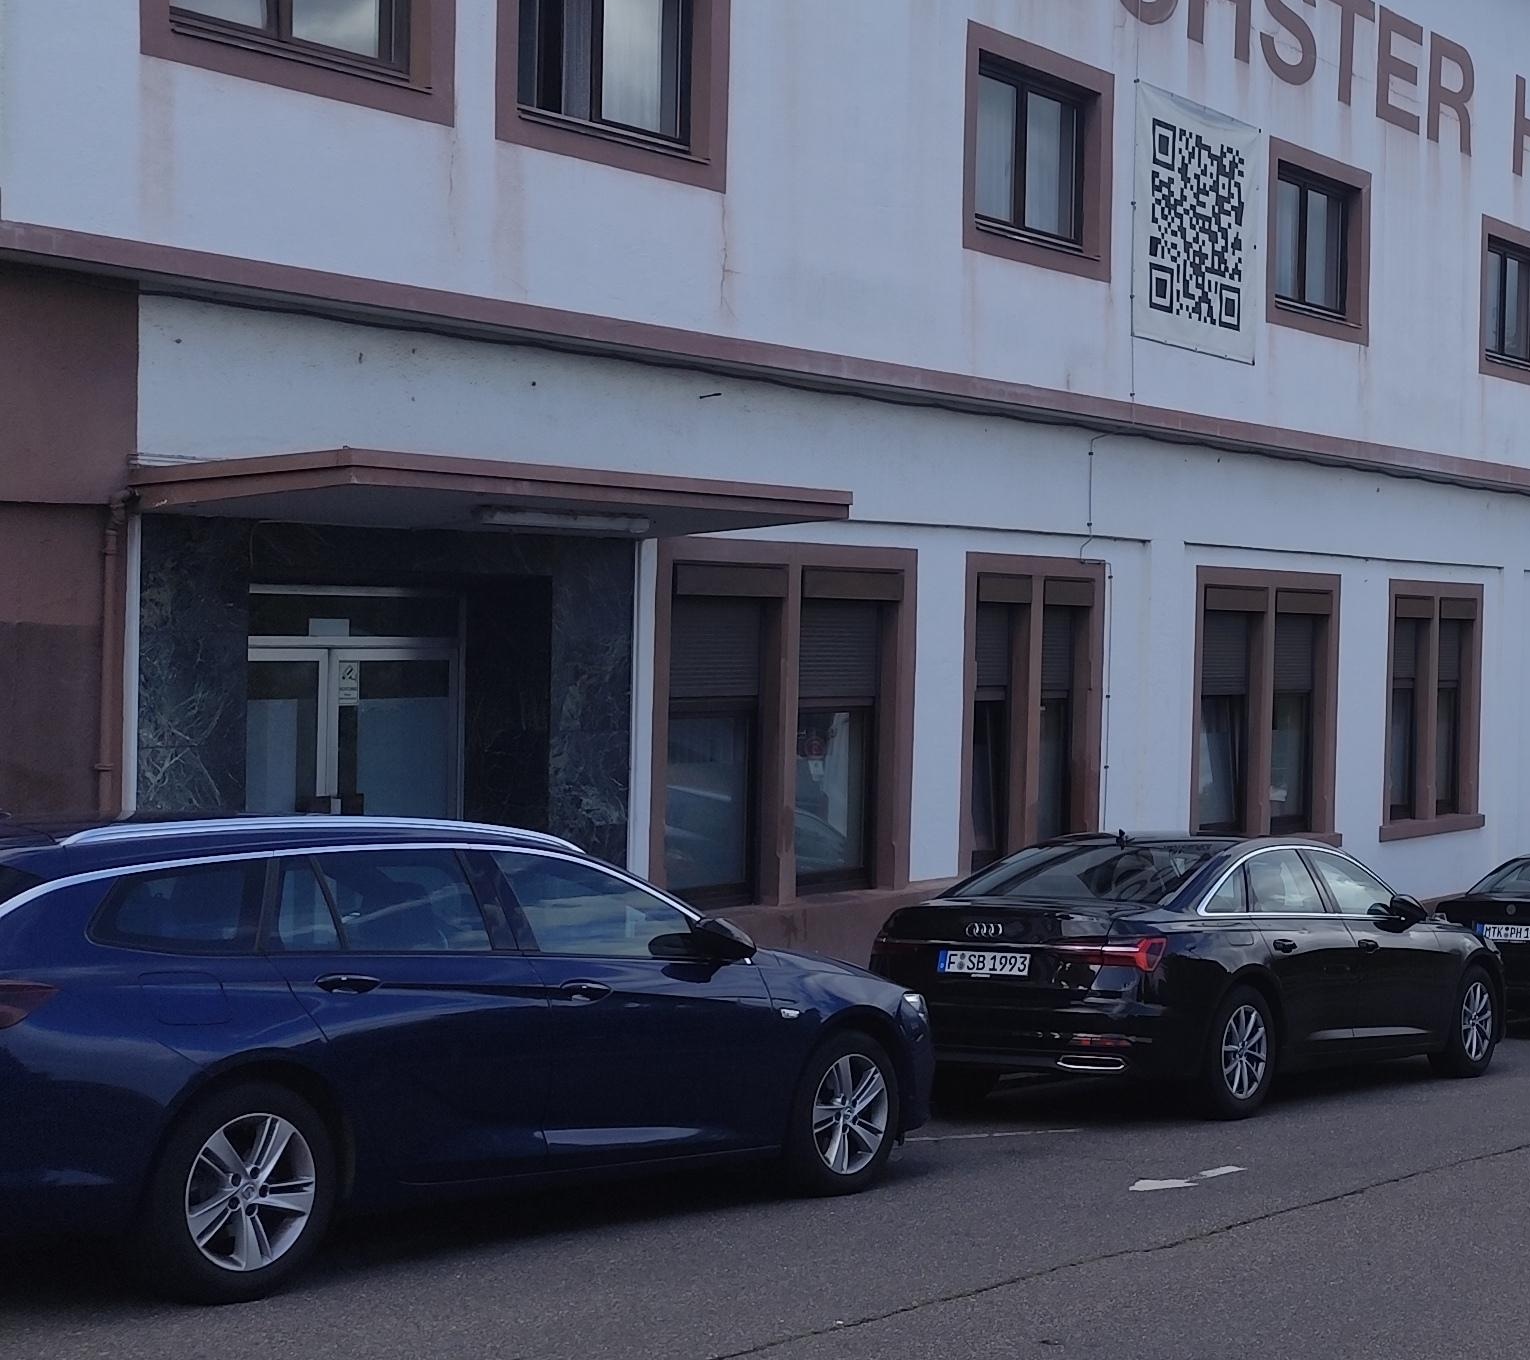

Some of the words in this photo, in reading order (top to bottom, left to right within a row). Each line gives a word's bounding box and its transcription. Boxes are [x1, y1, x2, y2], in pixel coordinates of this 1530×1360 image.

[1509, 926, 1523, 939] PH
[947, 953, 958, 970] F
[966, 953, 986, 971] SB
[988, 954, 1028, 973] 1993
